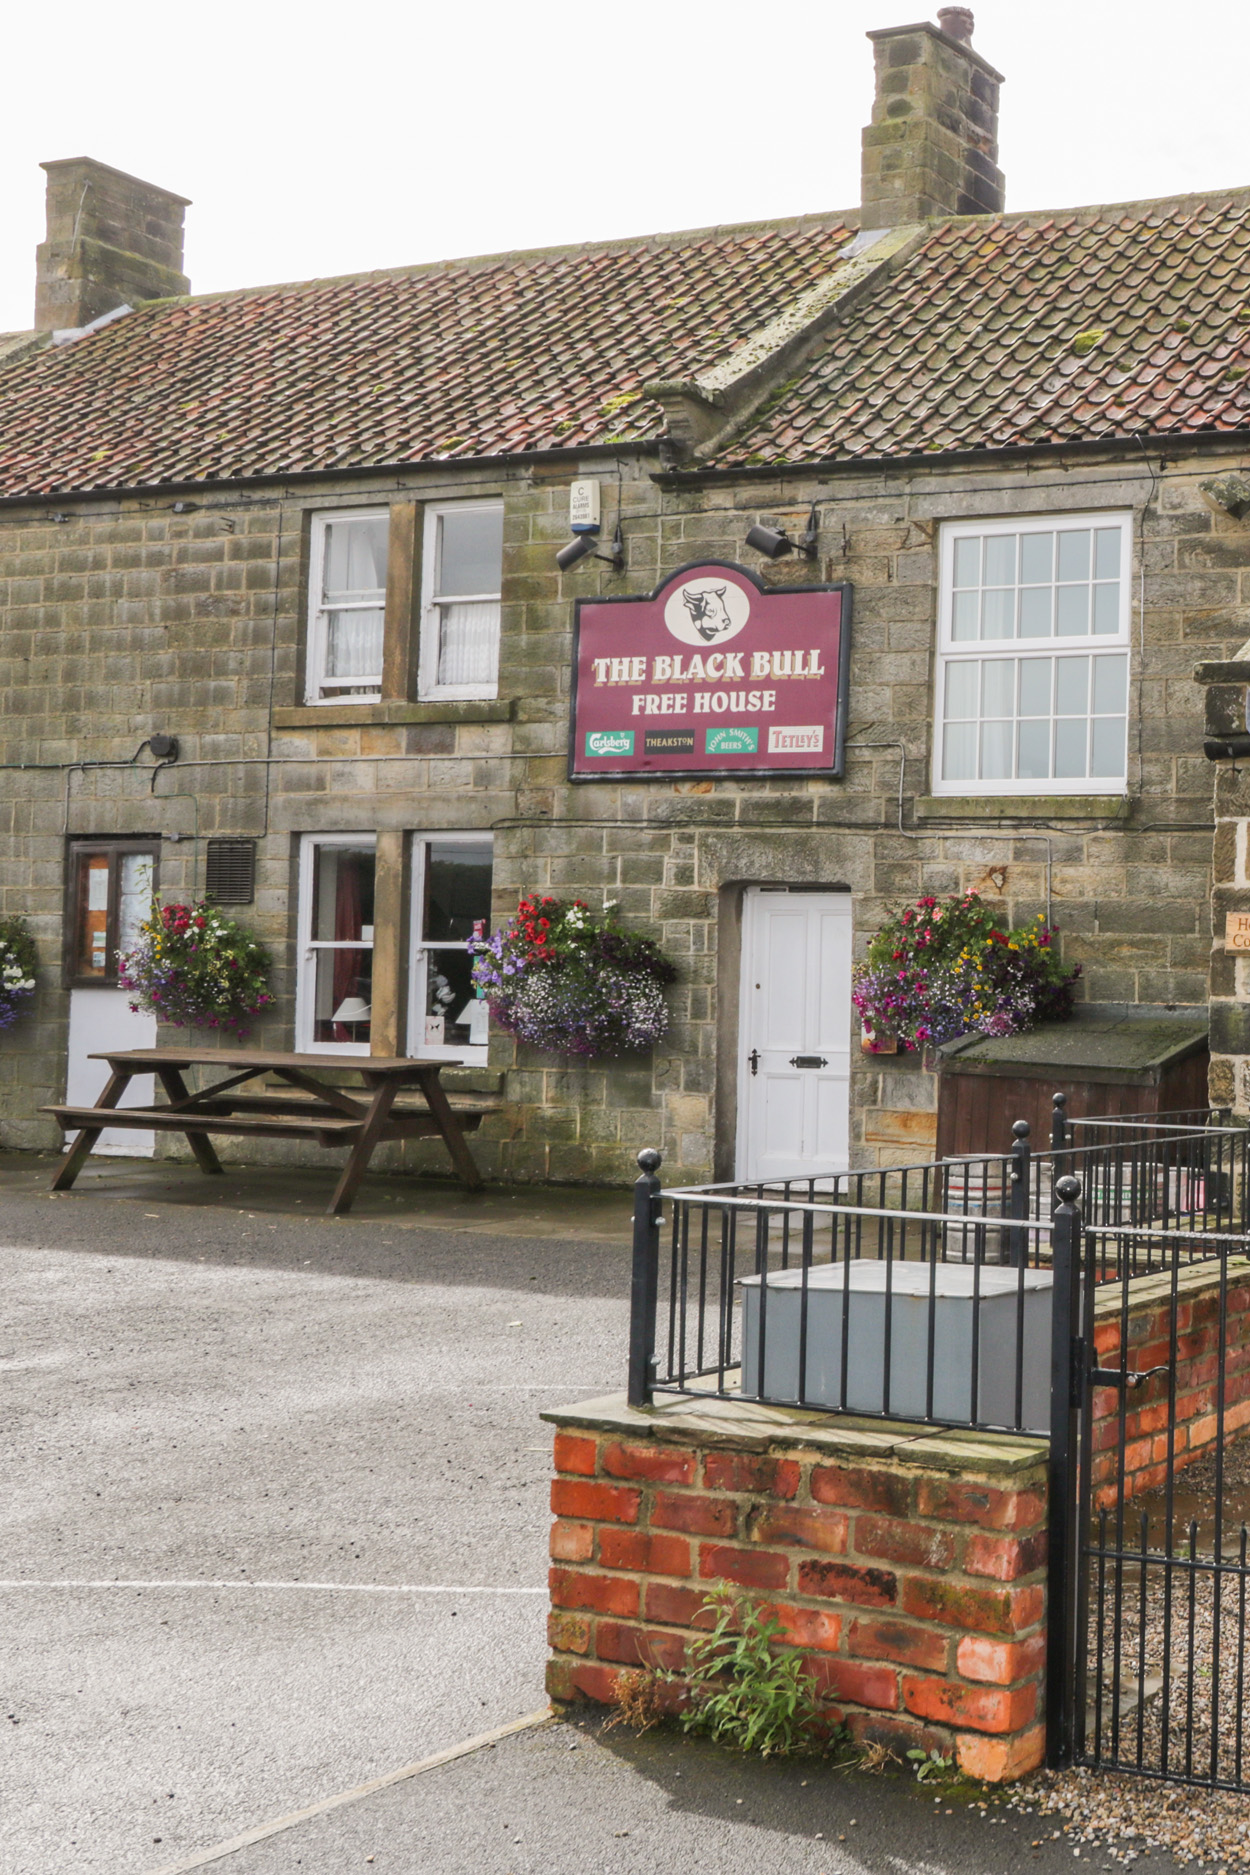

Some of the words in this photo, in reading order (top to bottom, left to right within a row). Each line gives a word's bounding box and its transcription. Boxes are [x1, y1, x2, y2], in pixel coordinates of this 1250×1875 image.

[592, 656, 647, 685] THE
[653, 652, 745, 683] BLACK
[750, 649, 825, 680] BULL
[631, 693, 687, 715] FREE
[693, 690, 776, 713] HOUSE
[589, 733, 630, 751] Carlsberg
[645, 737, 694, 747] THEAKSTON
[708, 731, 727, 752] JOHN
[729, 728, 755, 751] SMITH'S
[720, 741, 742, 750] BEERS
[772, 729, 820, 748] TETLEY'S
